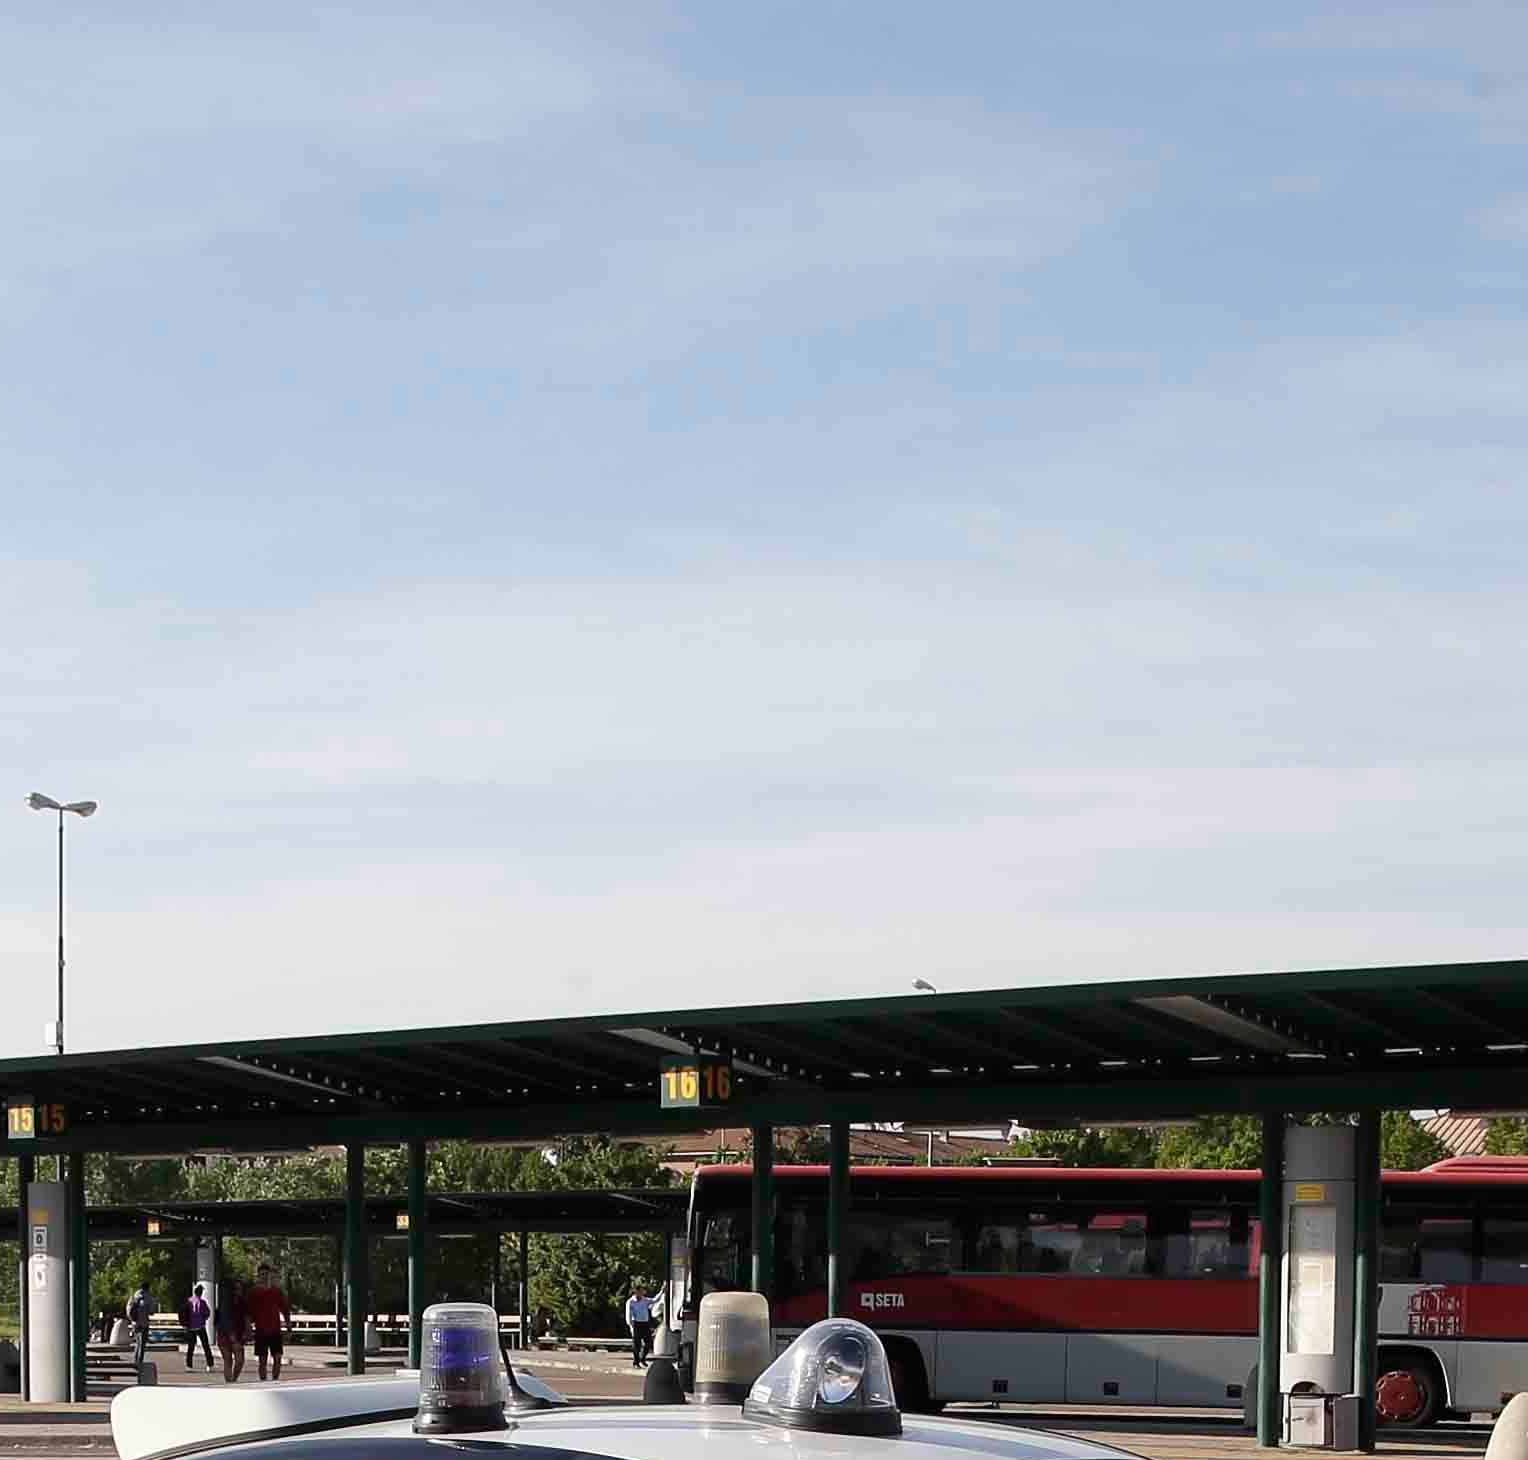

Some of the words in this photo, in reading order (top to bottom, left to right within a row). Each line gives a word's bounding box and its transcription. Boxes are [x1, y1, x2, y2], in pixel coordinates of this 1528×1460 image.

[664, 1066, 697, 1099] 16
[9, 1104, 34, 1132] 15
[875, 1293, 905, 1307] SETA
